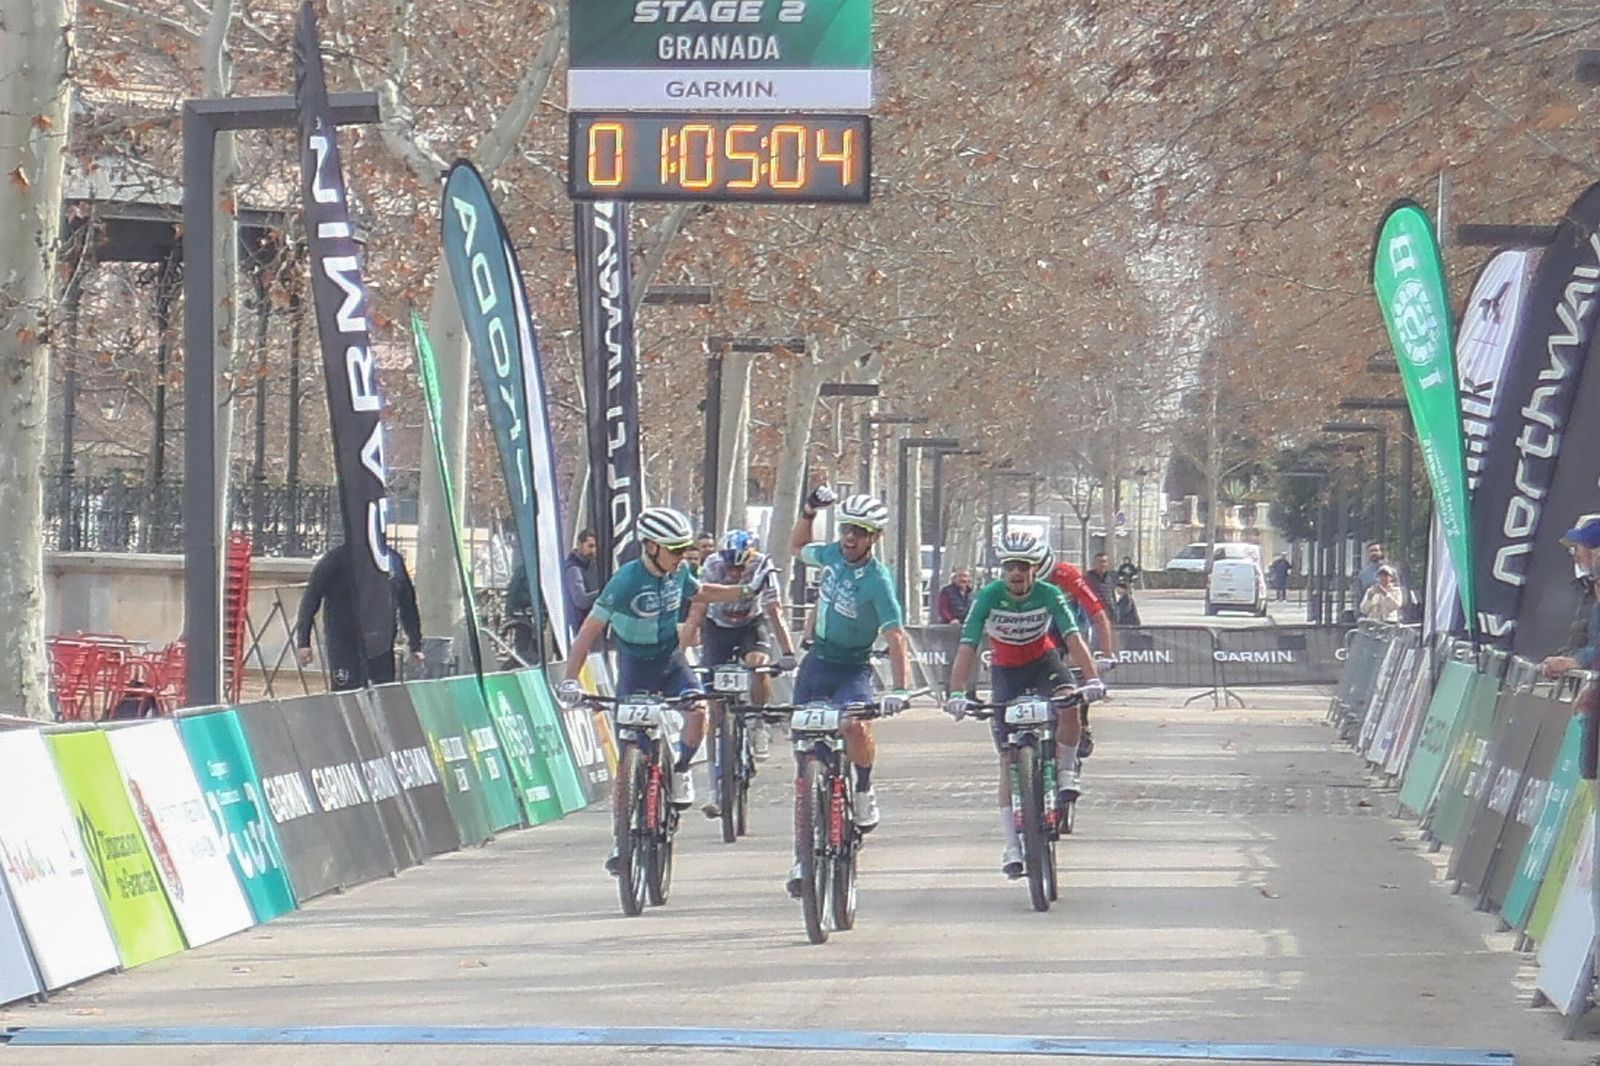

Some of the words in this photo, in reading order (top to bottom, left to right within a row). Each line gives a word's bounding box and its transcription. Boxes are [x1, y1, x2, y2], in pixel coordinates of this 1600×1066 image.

[633, 0, 761, 23] STAGE
[777, 0, 808, 23] 2
[658, 34, 781, 60] GRANADA
[665, 80, 774, 99] GARMIN
[588, 122, 624, 187] 0
[660, 124, 854, 189] 1:05:04
[309, 135, 390, 573] GARMIN
[1213, 650, 1292, 663] GARMIN
[628, 706, 651, 721] 7-2
[804, 710, 825, 726] 7-1
[1015, 704, 1036, 719] 3-1
